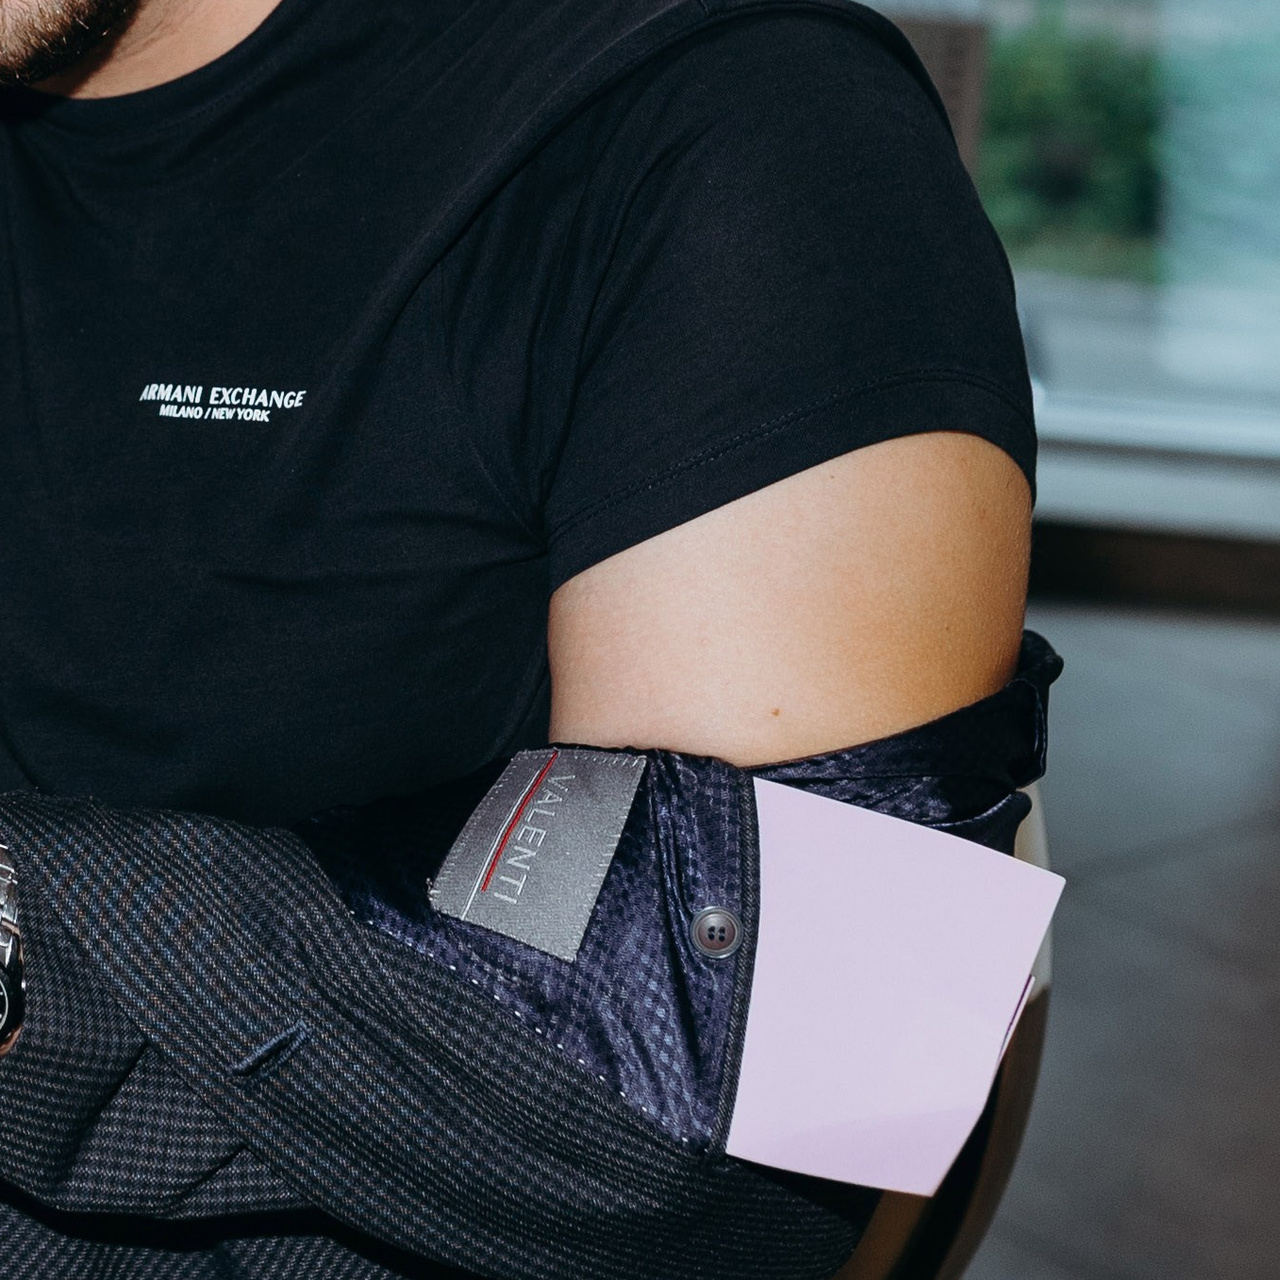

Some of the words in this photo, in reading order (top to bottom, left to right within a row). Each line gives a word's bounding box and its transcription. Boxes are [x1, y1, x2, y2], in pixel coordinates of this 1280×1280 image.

[138, 383, 203, 403] ARMANI
[209, 387, 307, 408] EXCHANGE
[158, 404, 204, 420] MILANO
[211, 407, 237, 420] NEW
[236, 408, 271, 422] YORK
[493, 774, 577, 904] VALENTI
